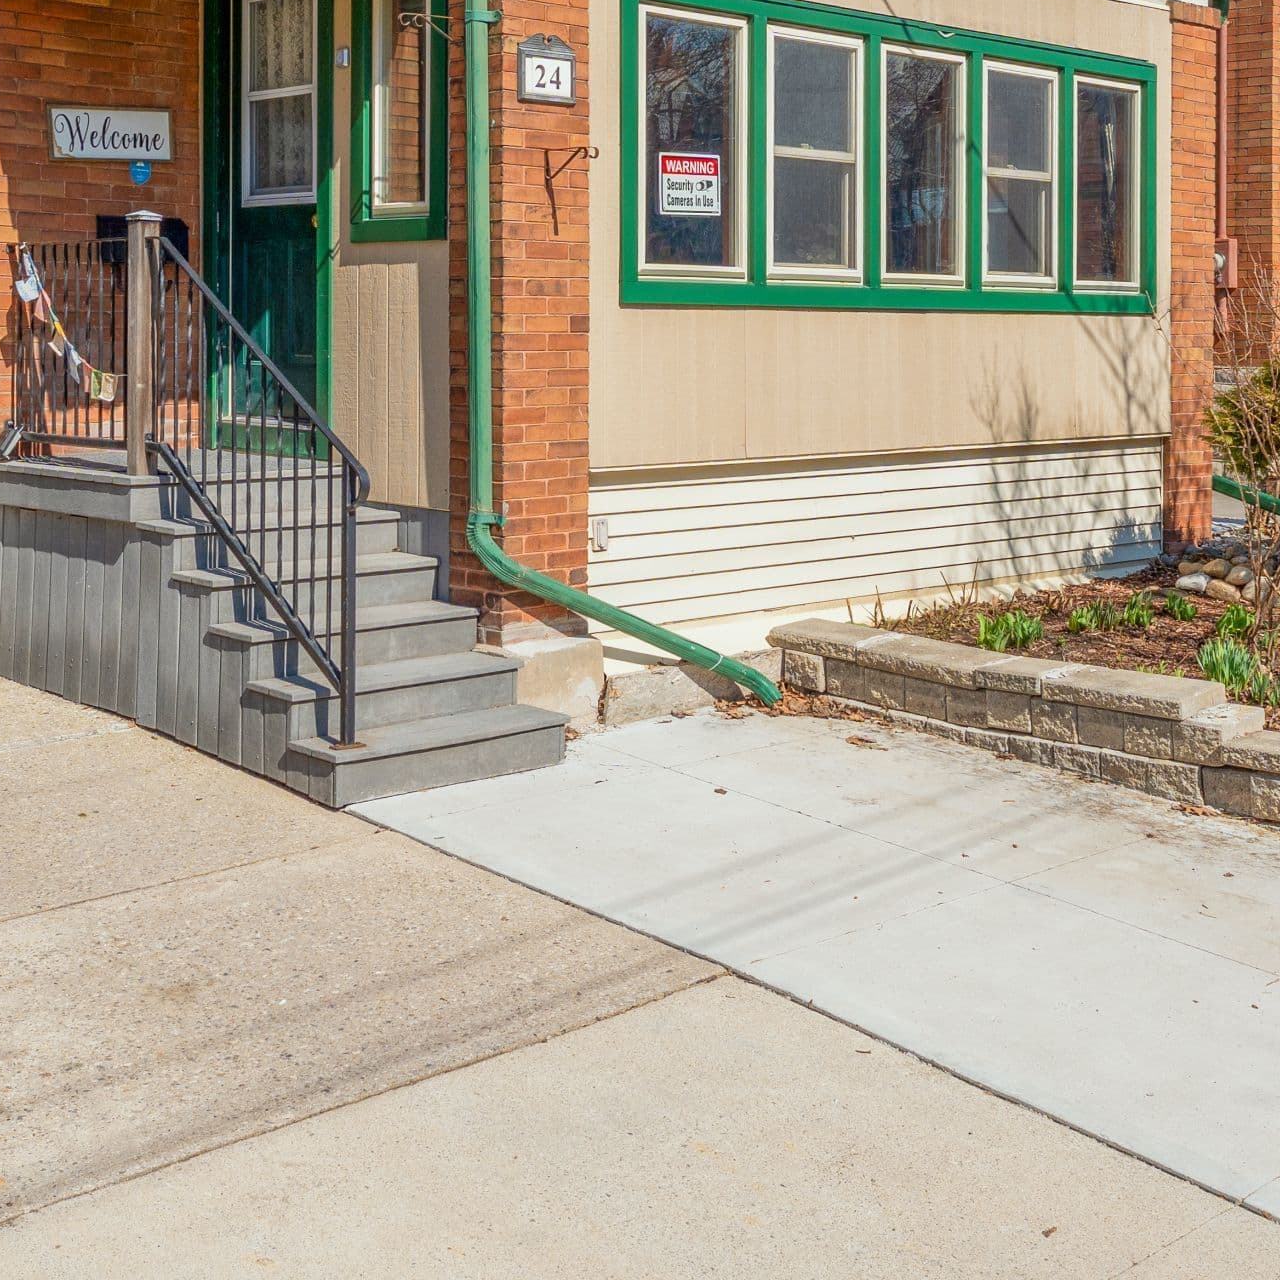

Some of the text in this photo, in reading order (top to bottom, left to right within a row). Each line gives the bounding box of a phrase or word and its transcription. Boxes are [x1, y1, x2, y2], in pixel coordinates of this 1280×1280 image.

[534, 64, 562, 90] 24
[54, 112, 165, 153] Welcome
[665, 160, 715, 174] WARNING
[666, 177, 694, 194] Security
[666, 193, 694, 207] Cameras
[702, 194, 714, 208] Use
